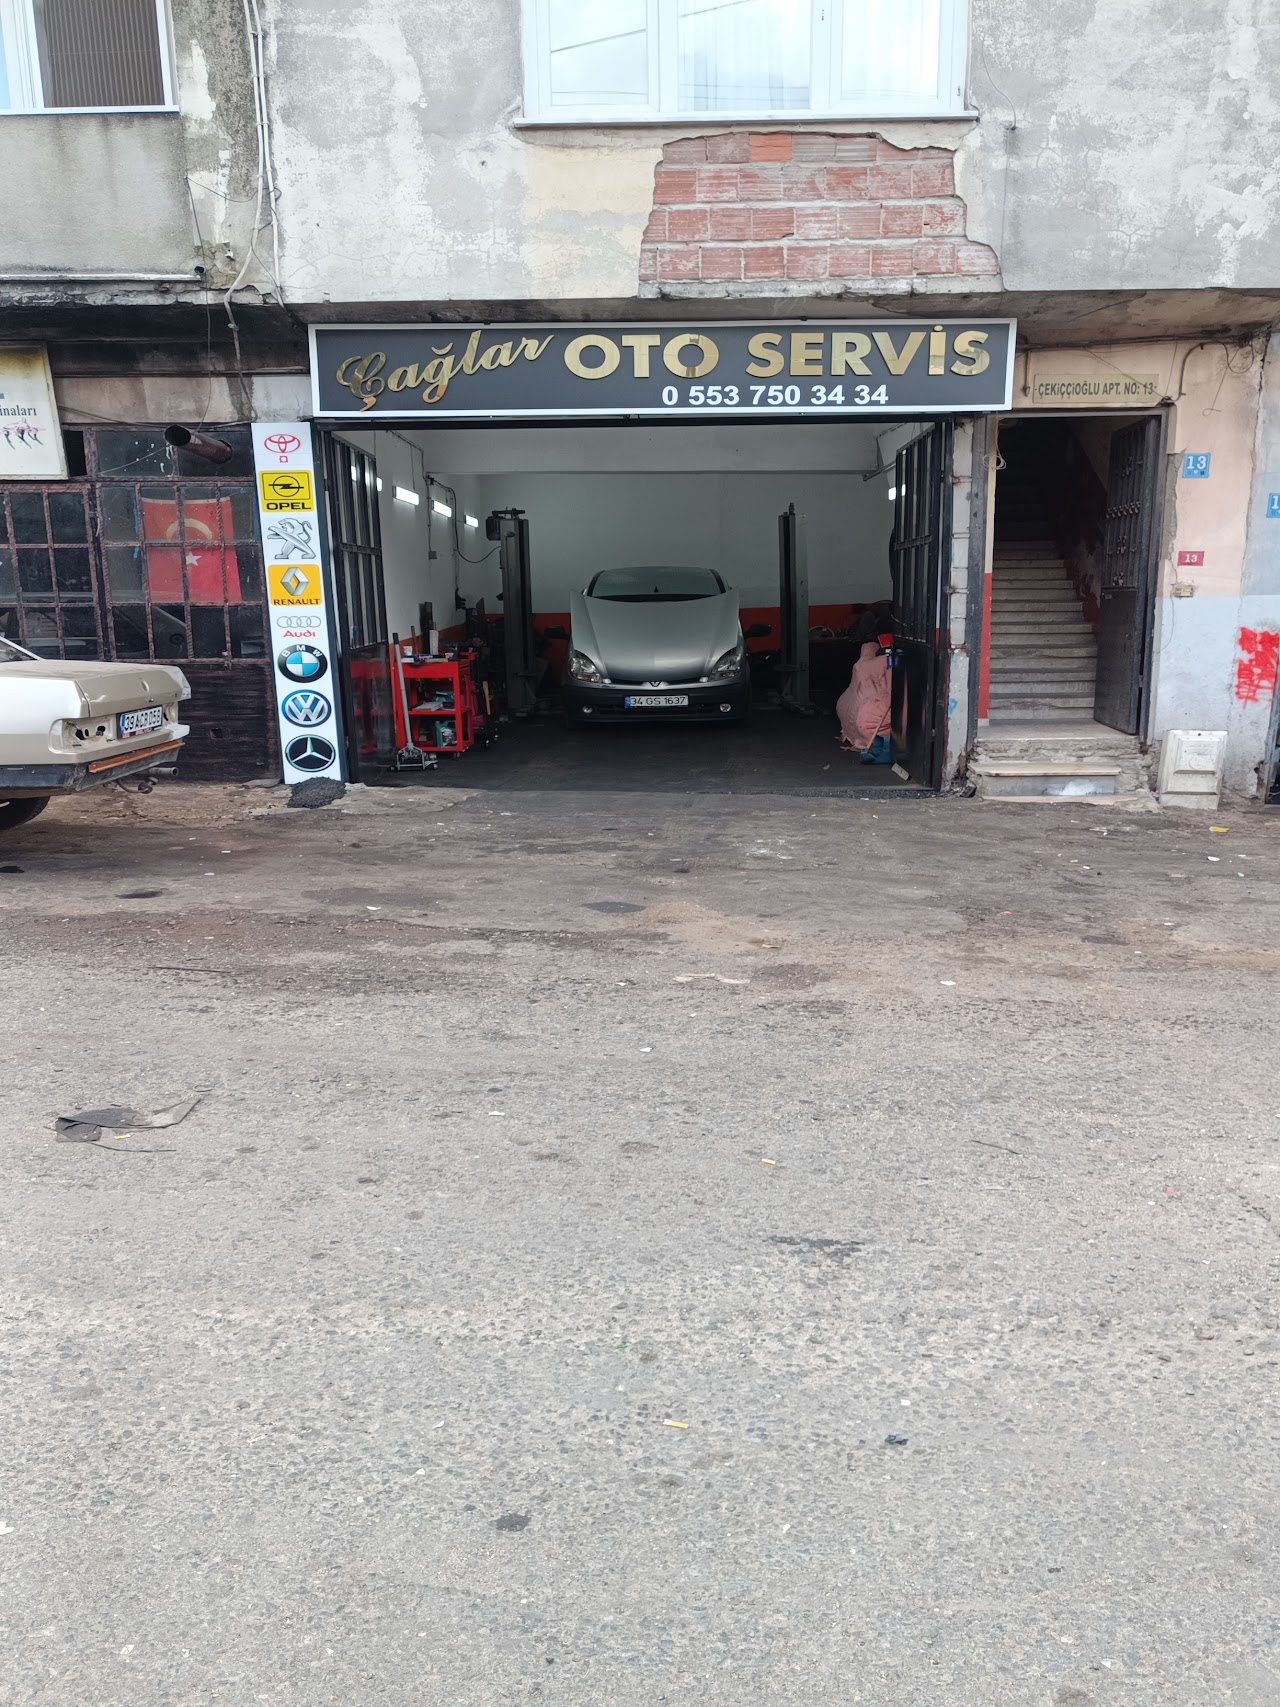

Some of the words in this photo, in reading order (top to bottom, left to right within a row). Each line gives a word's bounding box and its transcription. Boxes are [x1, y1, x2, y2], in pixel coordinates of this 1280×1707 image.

[336, 329, 555, 412] Çağlar
[563, 333, 719, 379] OTO
[745, 325, 991, 378] SERVİS
[662, 385, 679, 405] 0
[688, 385, 740, 405] 553
[749, 384, 801, 405] 750
[810, 384, 845, 405] 34
[853, 384, 889, 404] 34
[1102, 382, 1121, 395] APT.
[1124, 382, 1140, 395] NO:
[1186, 455, 1207, 470] 13
[266, 502, 312, 511] OPEL
[1184, 554, 1198, 563] 13
[273, 598, 320, 606] RENAULT
[280, 644, 323, 658] BMW
[664, 696, 686, 705] 1637
